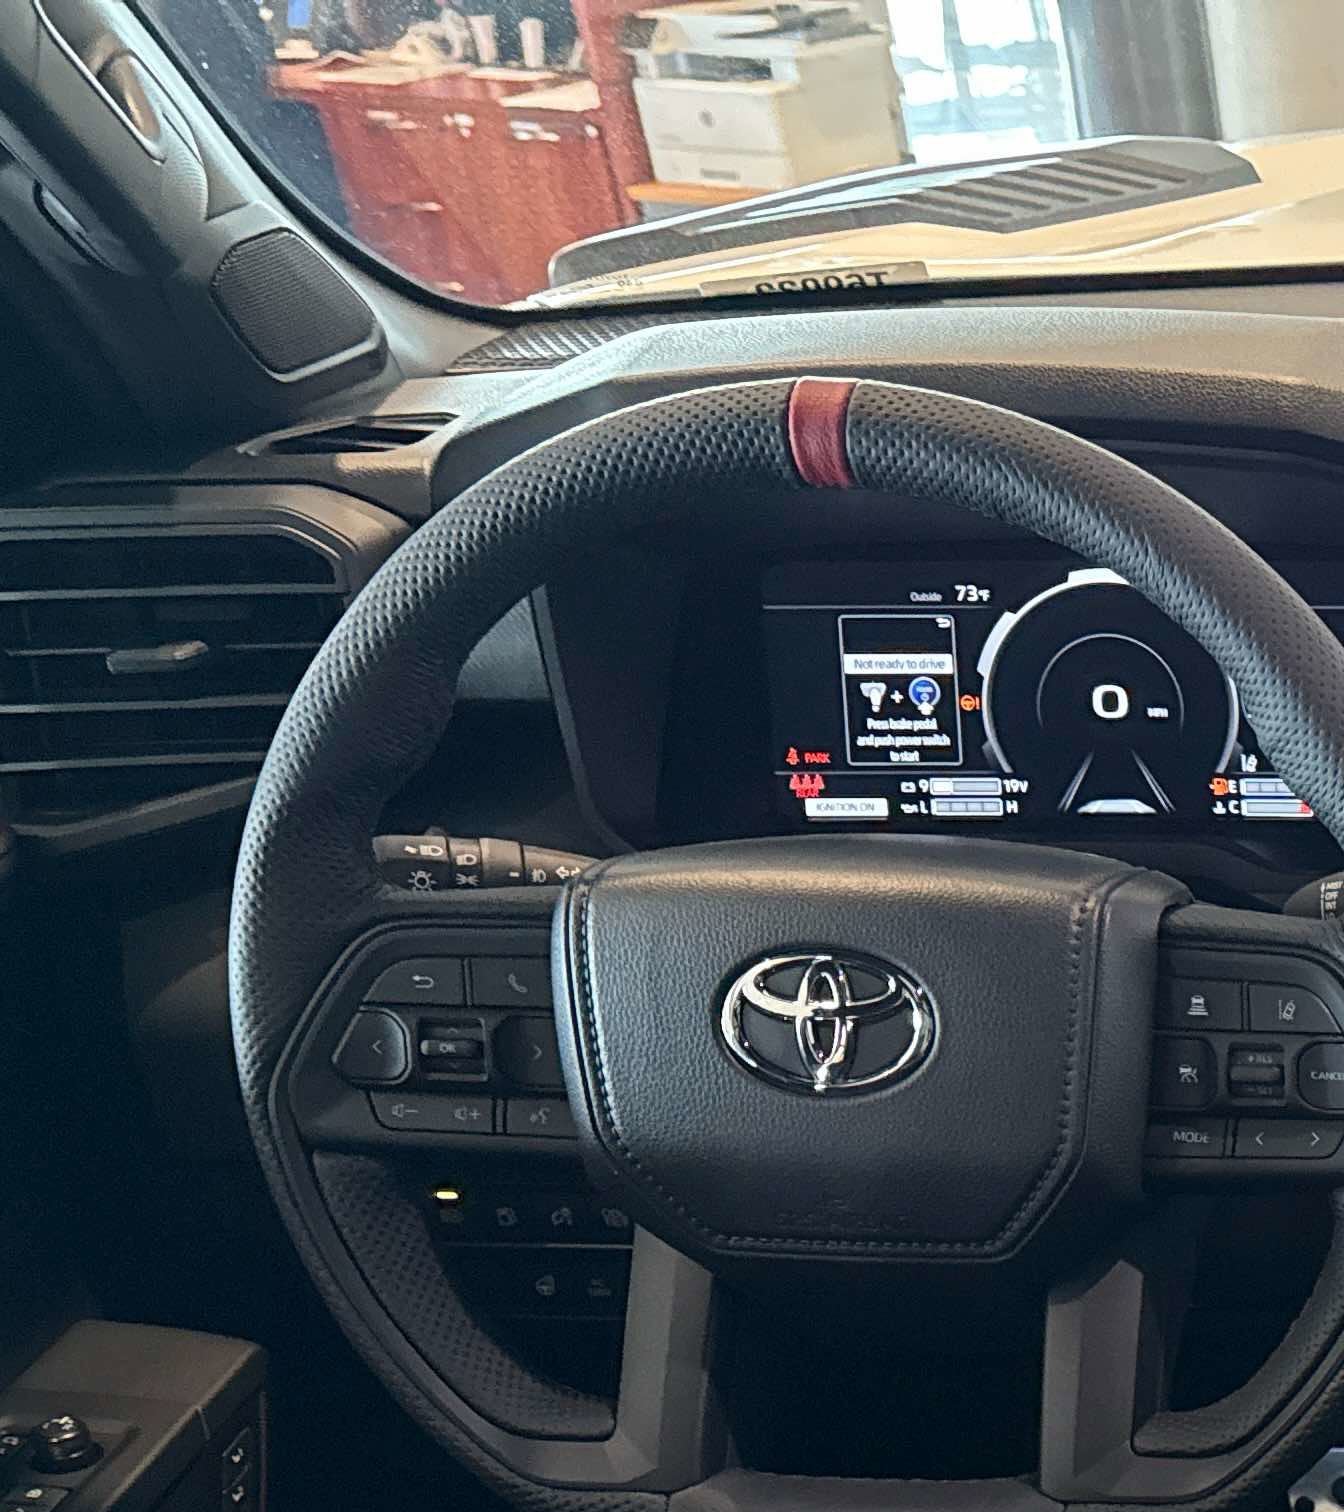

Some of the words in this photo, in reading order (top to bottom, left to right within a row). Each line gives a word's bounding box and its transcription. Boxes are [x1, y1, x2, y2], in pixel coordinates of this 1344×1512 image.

[910, 591, 943, 602] Outside
[854, 659, 874, 669] Not
[875, 659, 905, 672] ready
[906, 659, 916, 669] to
[919, 659, 945, 669] drive
[1092, 684, 1129, 718] 0
[804, 752, 831, 763] PARK
[816, 802, 859, 812] IGNITION
[860, 802, 875, 812] ON
[1173, 1131, 1211, 1143] MODE
